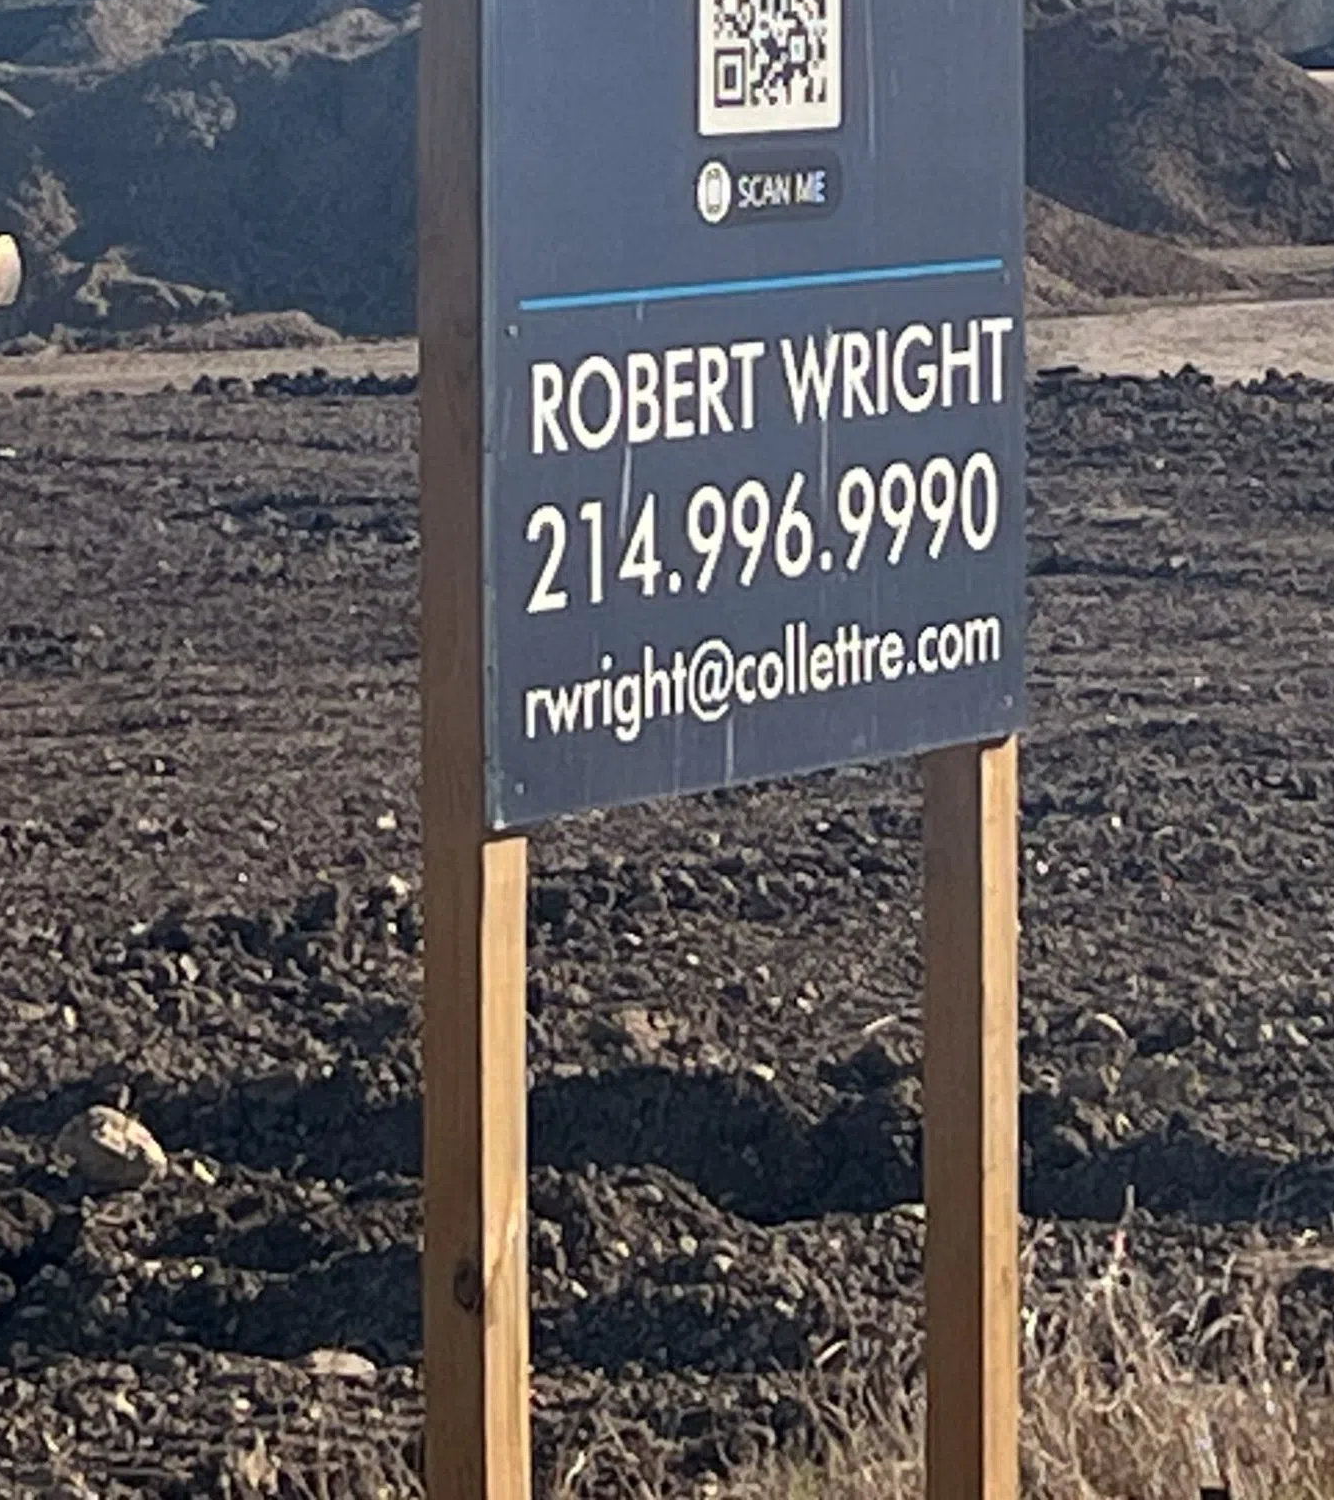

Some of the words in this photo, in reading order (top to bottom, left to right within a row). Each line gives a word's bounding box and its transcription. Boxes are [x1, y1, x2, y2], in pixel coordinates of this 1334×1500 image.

[738, 173, 792, 208] SCAN
[796, 170, 826, 202] ME
[531, 341, 765, 454] ROBERT
[780, 317, 1013, 424] WRIGHT
[525, 451, 999, 614] 214.996.9990
[524, 615, 1001, 743] rwright@collettre.com
